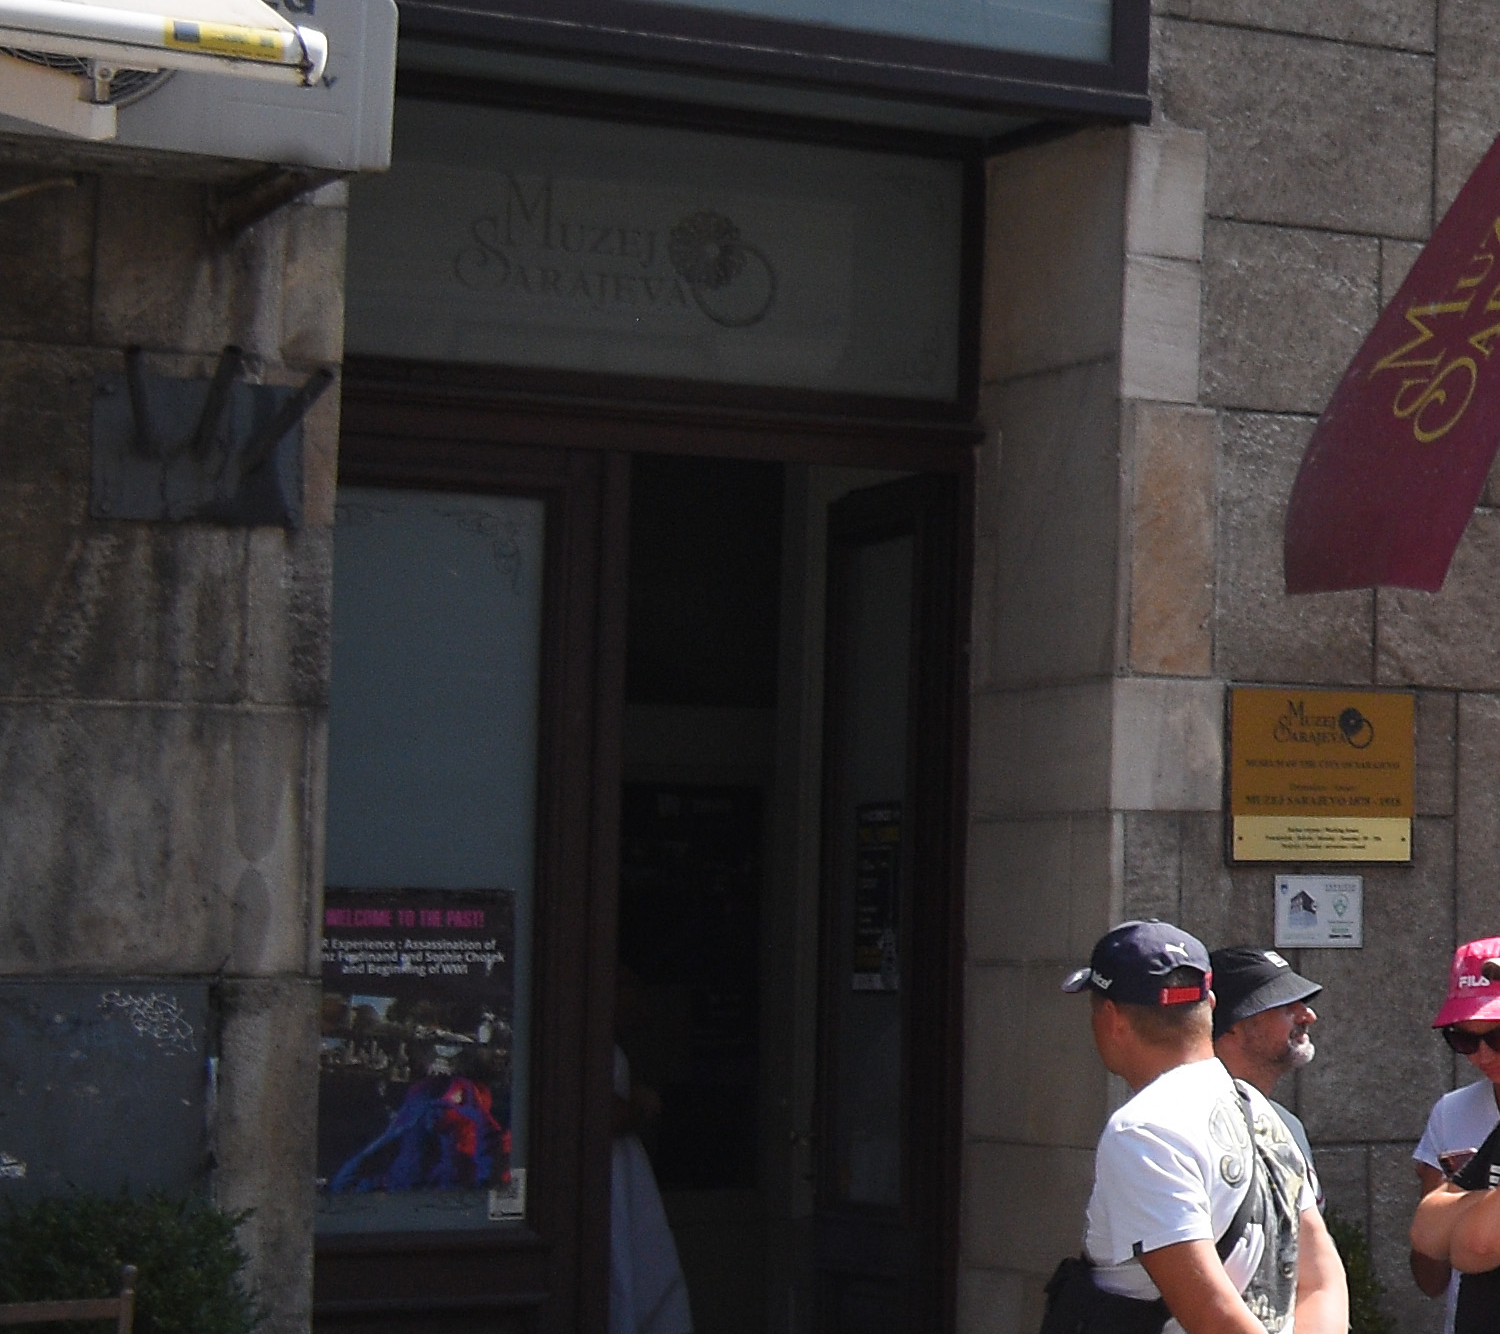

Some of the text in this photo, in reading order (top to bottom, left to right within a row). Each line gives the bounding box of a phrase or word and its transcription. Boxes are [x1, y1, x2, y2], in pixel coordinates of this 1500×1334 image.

[331, 938, 397, 952] Experience
[405, 938, 481, 951] Assassination
[484, 938, 497, 951] of
[1459, 974, 1491, 988] FILA
